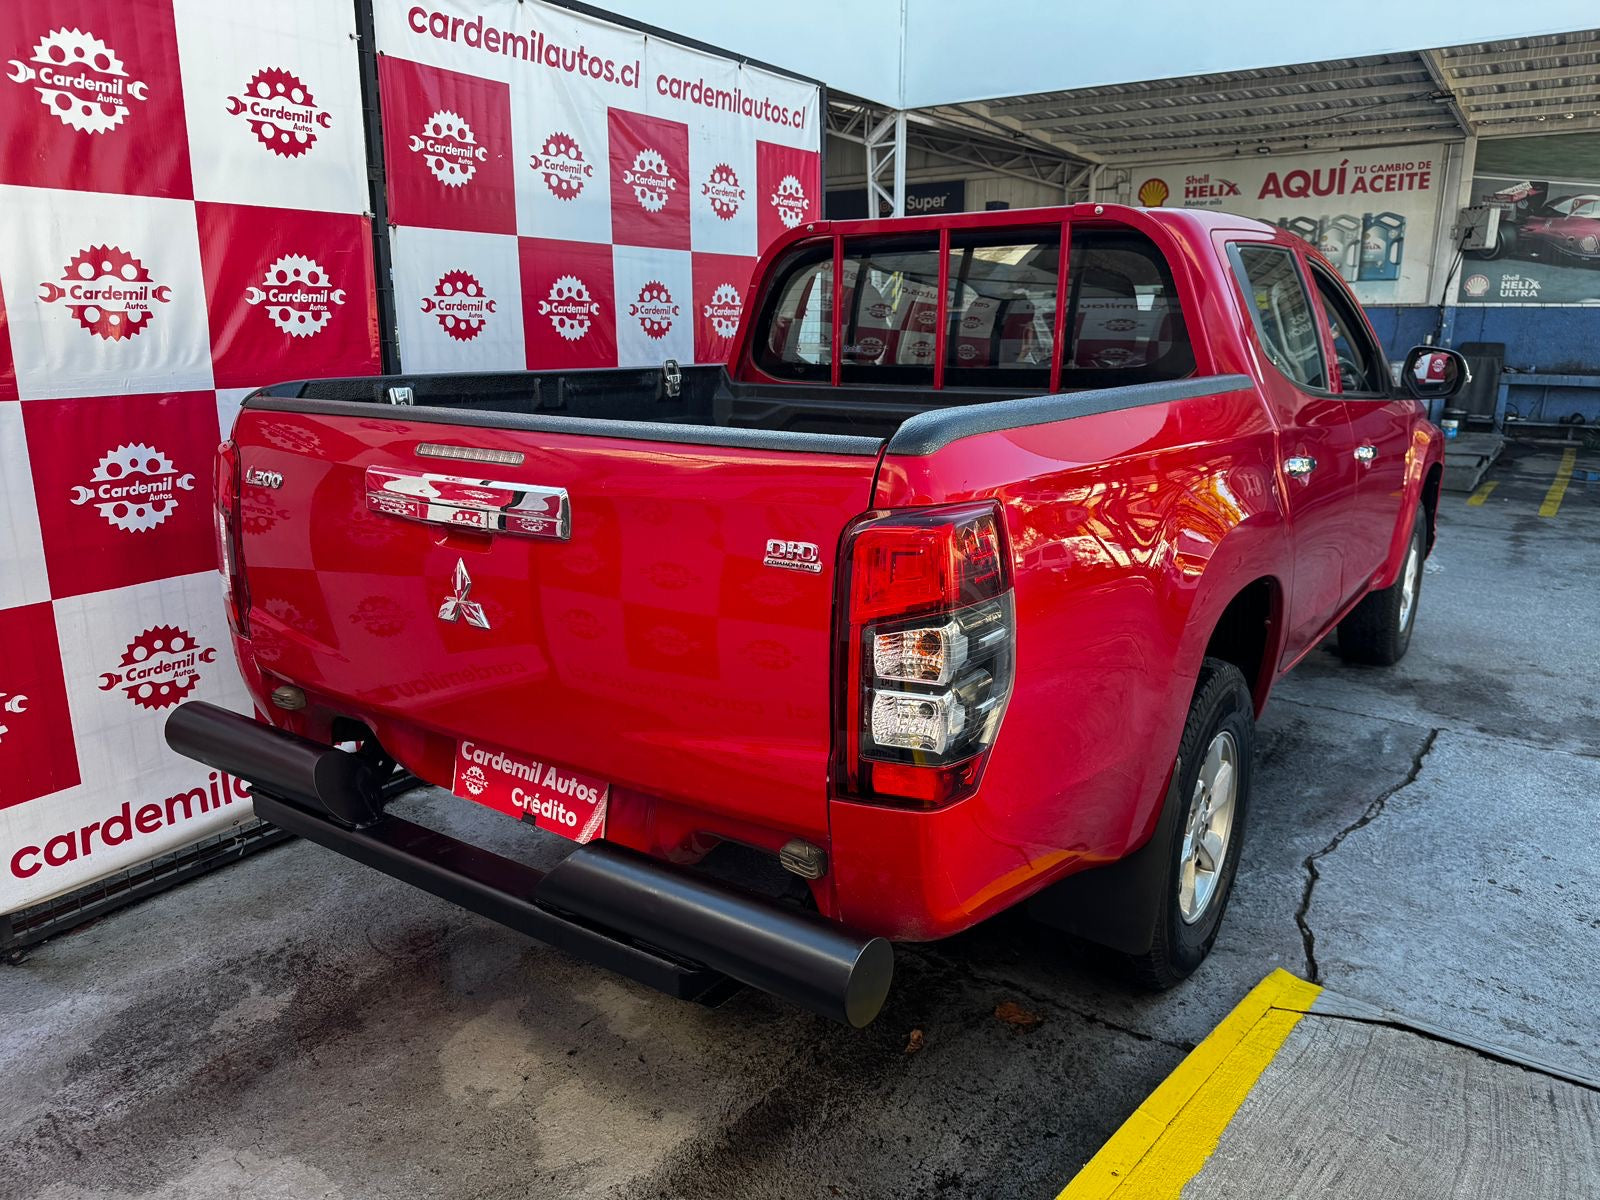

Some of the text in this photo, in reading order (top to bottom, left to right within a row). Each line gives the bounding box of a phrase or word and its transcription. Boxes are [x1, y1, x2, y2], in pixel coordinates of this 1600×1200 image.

[408, 6, 640, 88] cardemilautos.cl
[39, 68, 122, 95] Cardemil
[96, 93, 123, 105] Autos
[656, 74, 806, 129] cardemilautos.cl
[250, 102, 313, 123] Cardemil
[293, 122, 313, 133] Autos
[426, 140, 473, 158] Cardemil
[458, 156, 473, 166] Autos
[544, 159, 582, 174] Cardemil
[1353, 161, 1432, 174] TU CAMBIO DE
[634, 174, 667, 188] Cardemil
[1185, 174, 1209, 185] Shell
[1258, 159, 1349, 200] AQUÍ
[1350, 172, 1431, 194] ACEITE
[711, 186, 738, 198] Cardemil
[1184, 179, 1241, 199] HELIX
[779, 197, 803, 208] Cardemil
[907, 195, 946, 211] Super
[1500, 278, 1541, 290] HELIX
[69, 285, 148, 301] Cardemil
[269, 290, 327, 303] Cardemil
[1500, 290, 1538, 298] ULTRA
[124, 301, 148, 311] Autos
[309, 303, 327, 311] Autos
[438, 300, 483, 312] Cardemil
[551, 302, 589, 314] Cardemil
[640, 305, 671, 315] Cardemil
[98, 477, 172, 499] Cardemil
[149, 493, 172, 501] Autos
[126, 653, 195, 682] Cardemil
[173, 667, 195, 679] Autos
[461, 741, 598, 805] Cardemil Autos
[511, 787, 577, 827] Crédito
